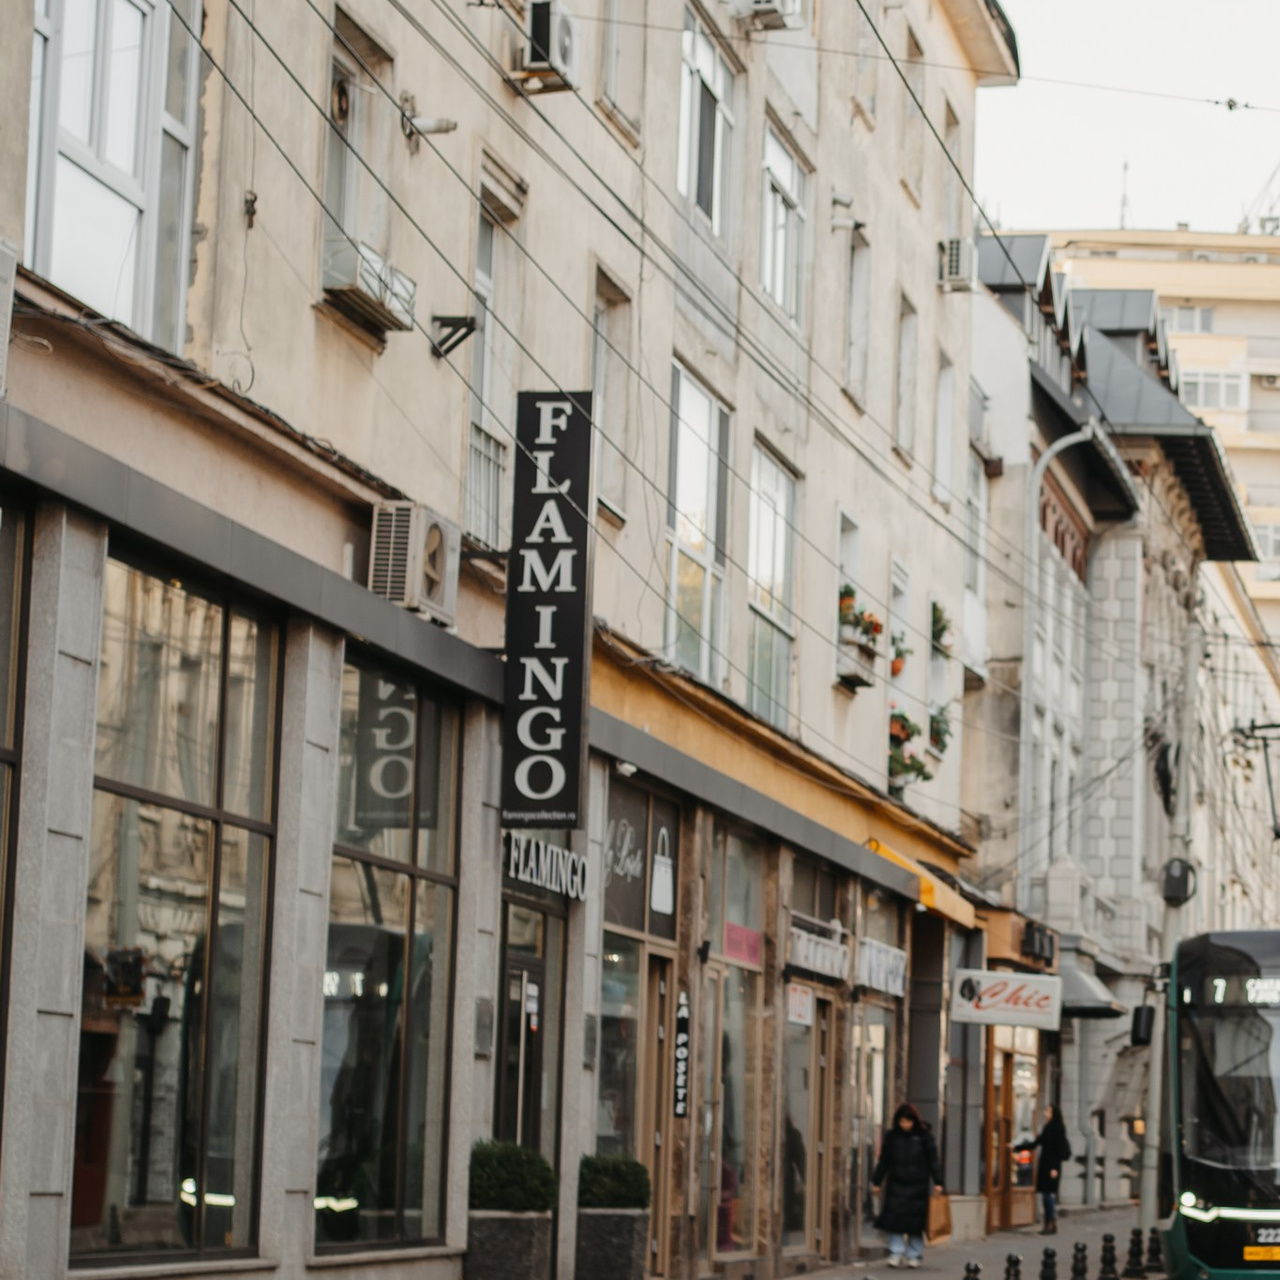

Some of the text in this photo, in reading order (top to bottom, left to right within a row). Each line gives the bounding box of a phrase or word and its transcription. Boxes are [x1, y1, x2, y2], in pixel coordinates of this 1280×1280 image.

[514, 401, 577, 800] FLAMINGO
[509, 832, 588, 902] FLAMINGO
[974, 980, 1052, 1011] Chic
[1212, 978, 1227, 1004] 7
[674, 1032, 689, 1115] POSETE
